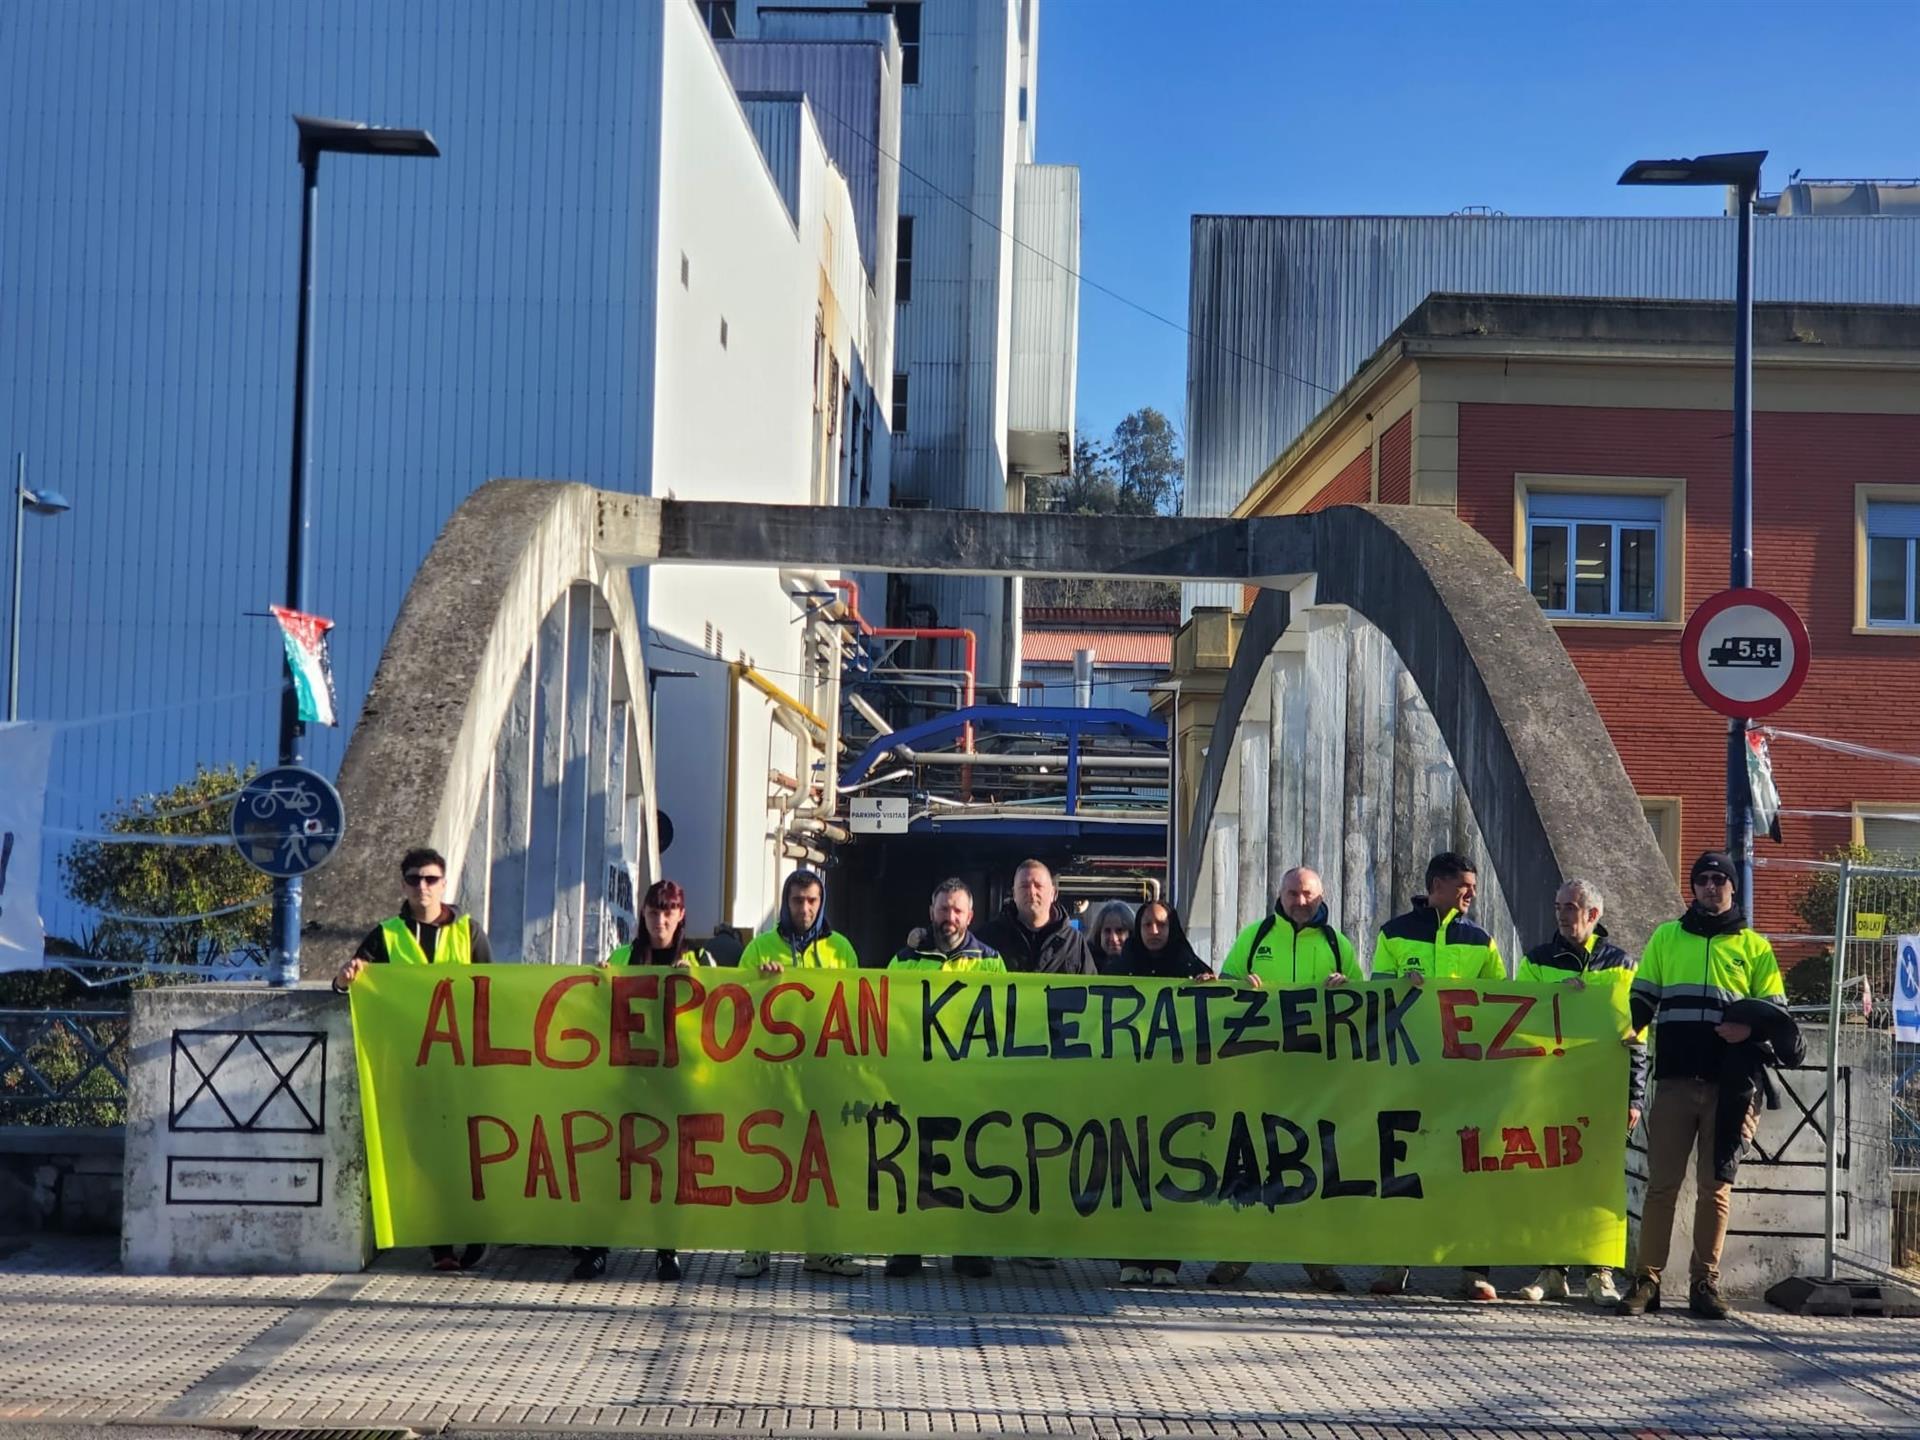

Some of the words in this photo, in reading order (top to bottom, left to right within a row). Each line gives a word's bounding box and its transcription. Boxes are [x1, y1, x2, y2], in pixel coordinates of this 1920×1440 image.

[416, 974, 889, 1069] ALGEPOSAN
[920, 980, 1423, 1065] KALERATZERIK
[1437, 989, 1566, 1061] EZ!
[467, 1109, 840, 1208] PAPRESA
[866, 1106, 1424, 1217] RESPONSABLE
[1458, 1124, 1585, 1173] LAB
